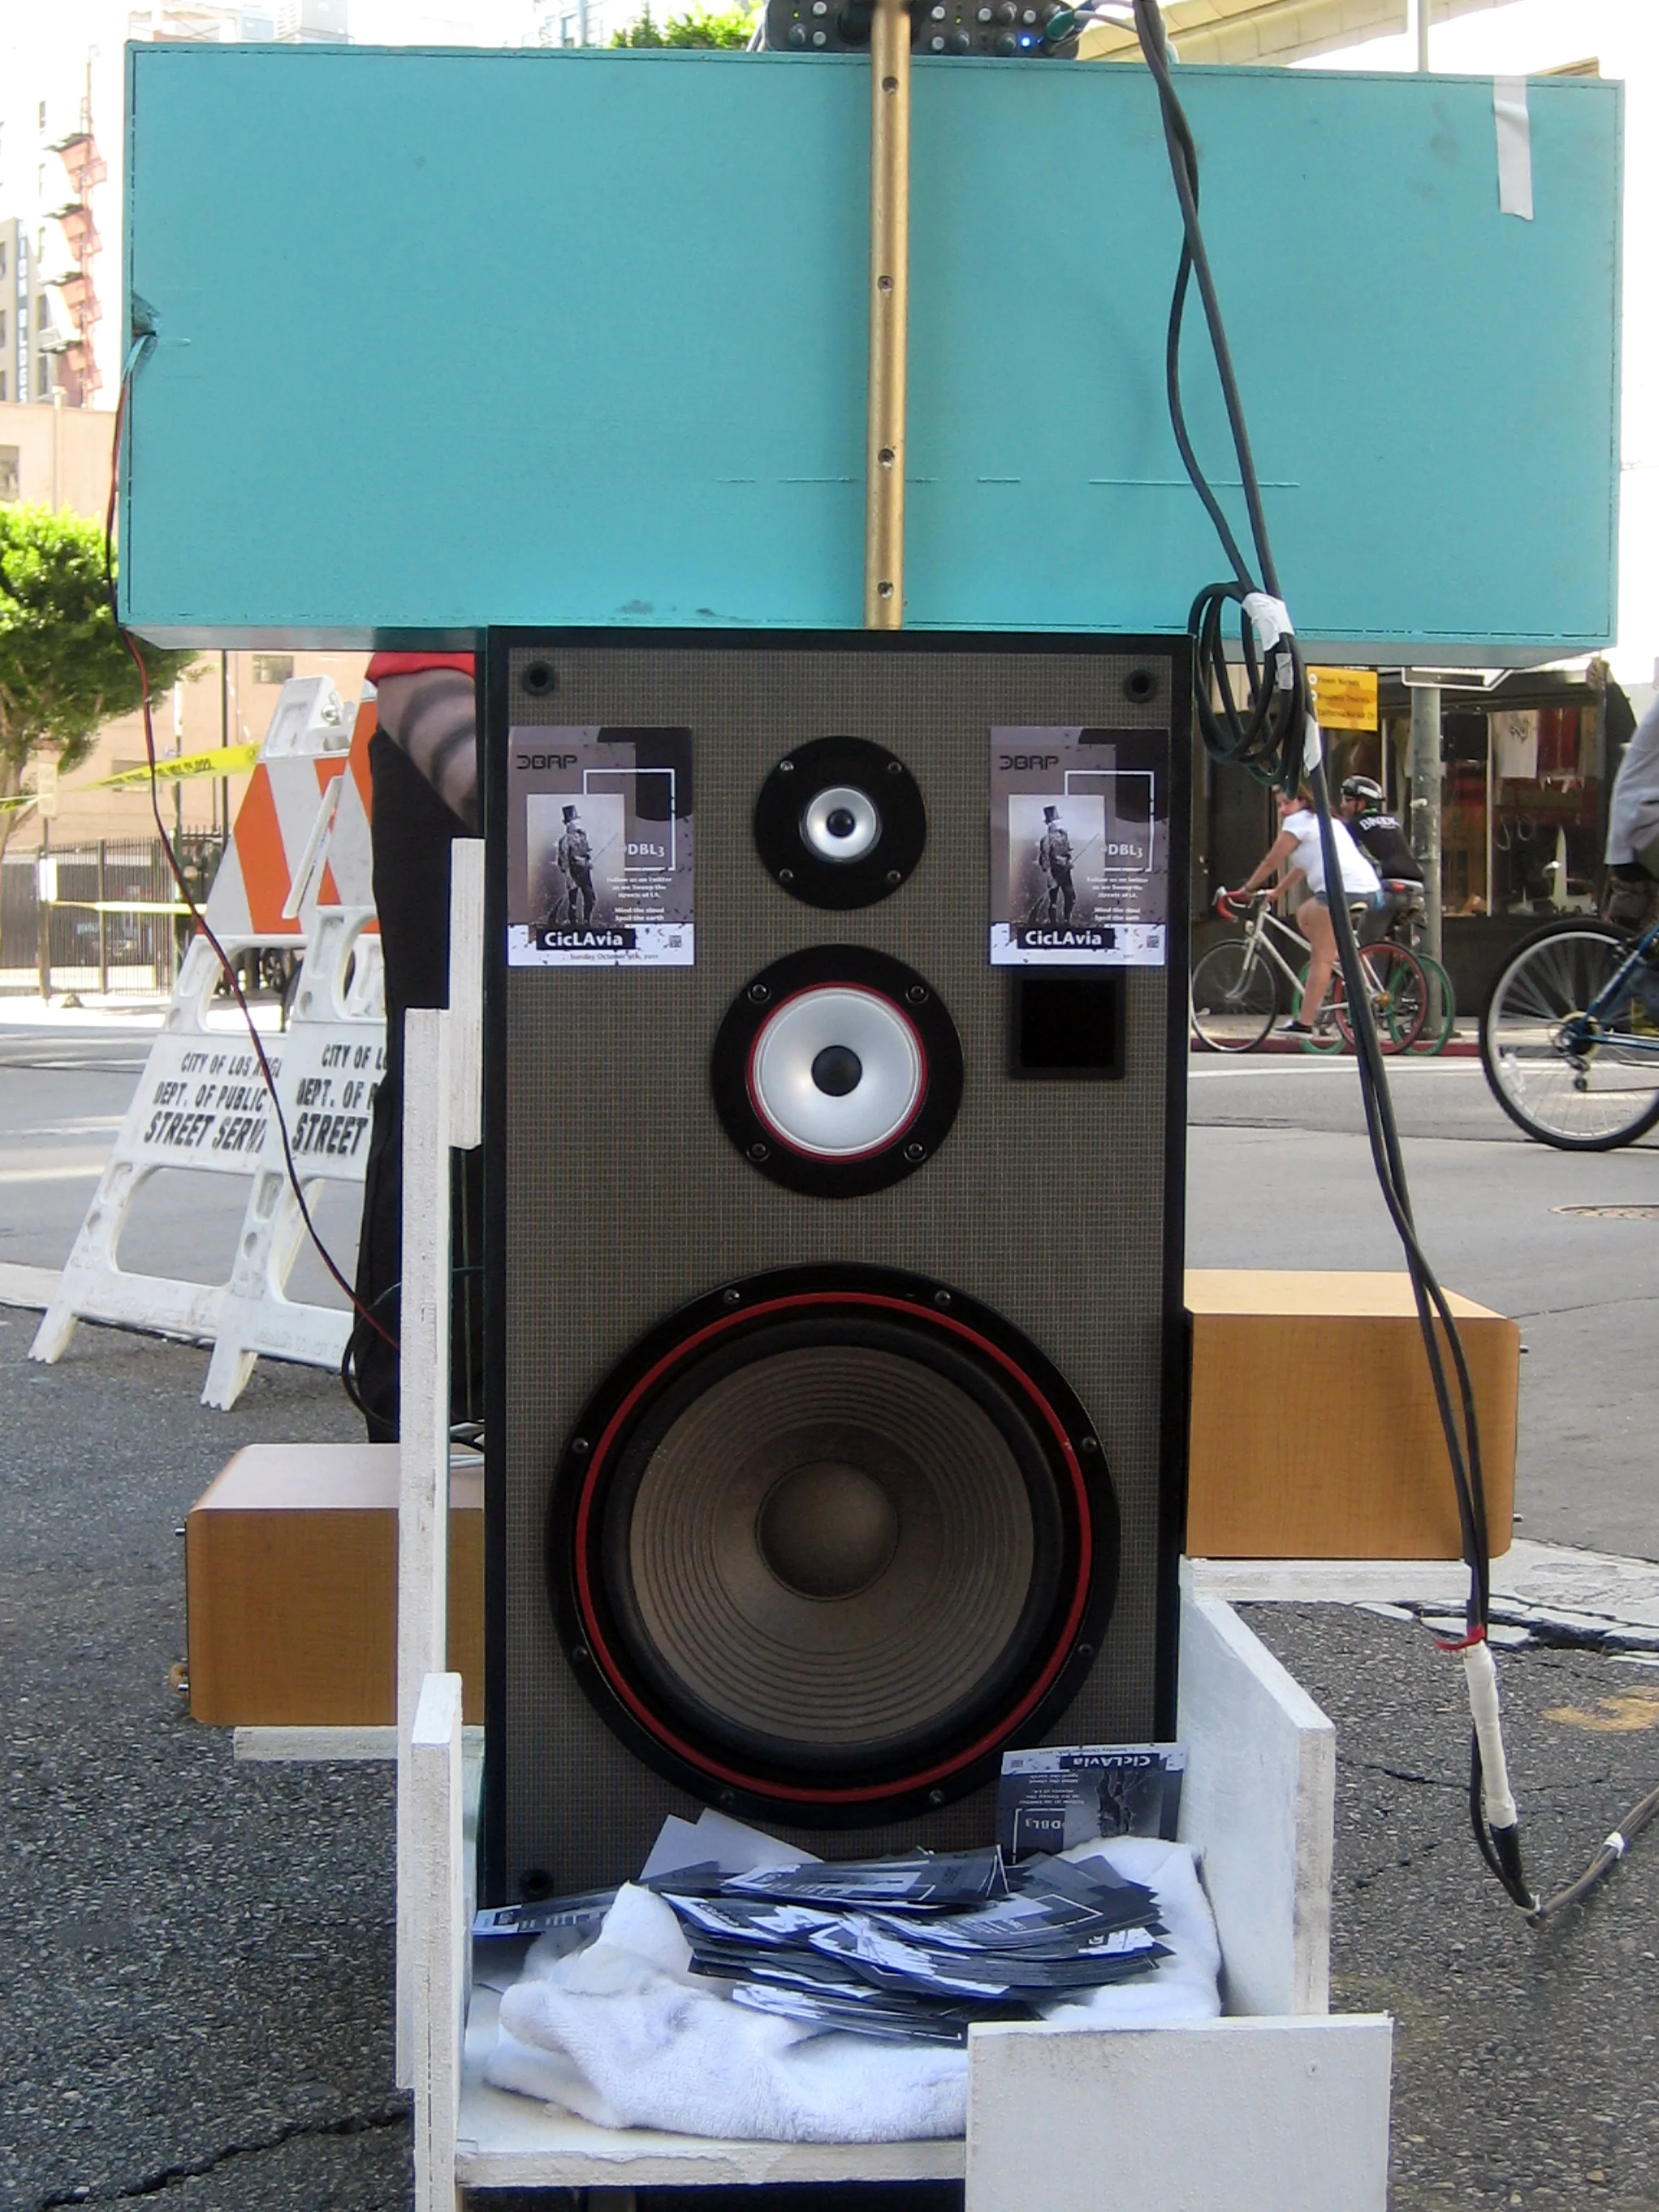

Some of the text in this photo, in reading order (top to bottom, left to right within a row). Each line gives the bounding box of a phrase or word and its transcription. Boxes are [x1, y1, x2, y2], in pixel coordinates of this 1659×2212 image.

[544, 932, 623, 948] CicLAvia
[1025, 931, 1102, 946] CicLAvia
[181, 1052, 209, 1074] CITY
[209, 1054, 227, 1075] OF
[228, 1056, 252, 1077] LOS
[322, 1044, 351, 1068] CITY
[354, 1046, 372, 1069] OF
[153, 1081, 268, 1113] DEPT. OF PUBLIC
[296, 1077, 334, 1107] DEPT.
[343, 1080, 365, 1109] OF
[143, 1110, 216, 1148] STREET
[292, 1112, 369, 1156] STREET
[1073, 1754, 1151, 1768] CicLAvia
